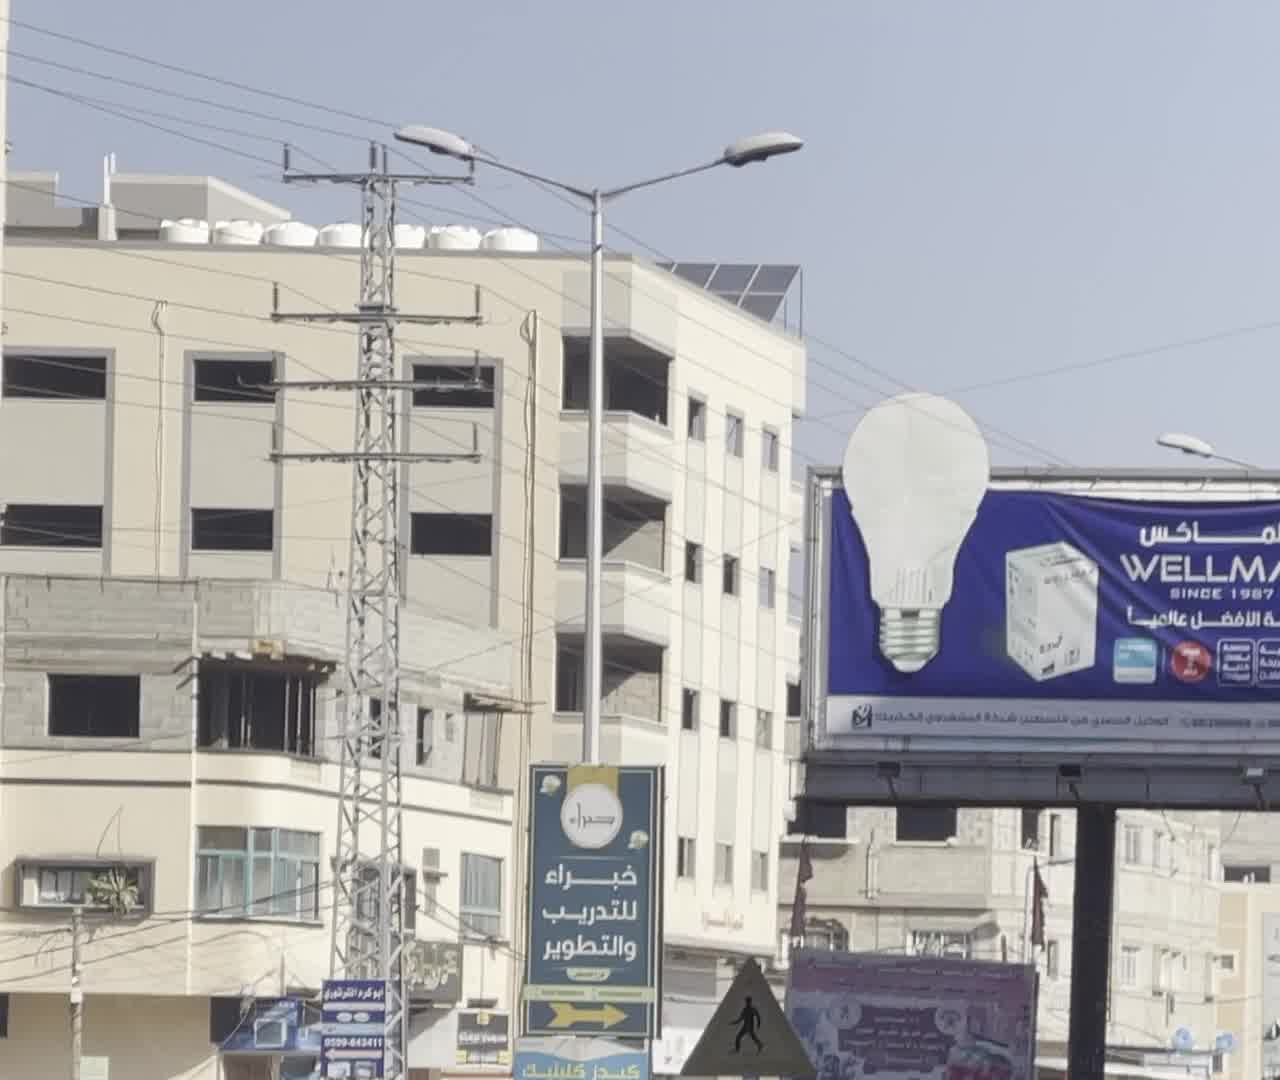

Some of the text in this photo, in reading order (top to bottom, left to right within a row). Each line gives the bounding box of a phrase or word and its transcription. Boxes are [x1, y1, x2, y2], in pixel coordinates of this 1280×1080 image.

[1170, 587, 1274, 600] SINCE 1987
[544, 864, 637, 891] خبراء
[542, 899, 637, 926] للتدريب
[542, 934, 637, 961] والتطوير
